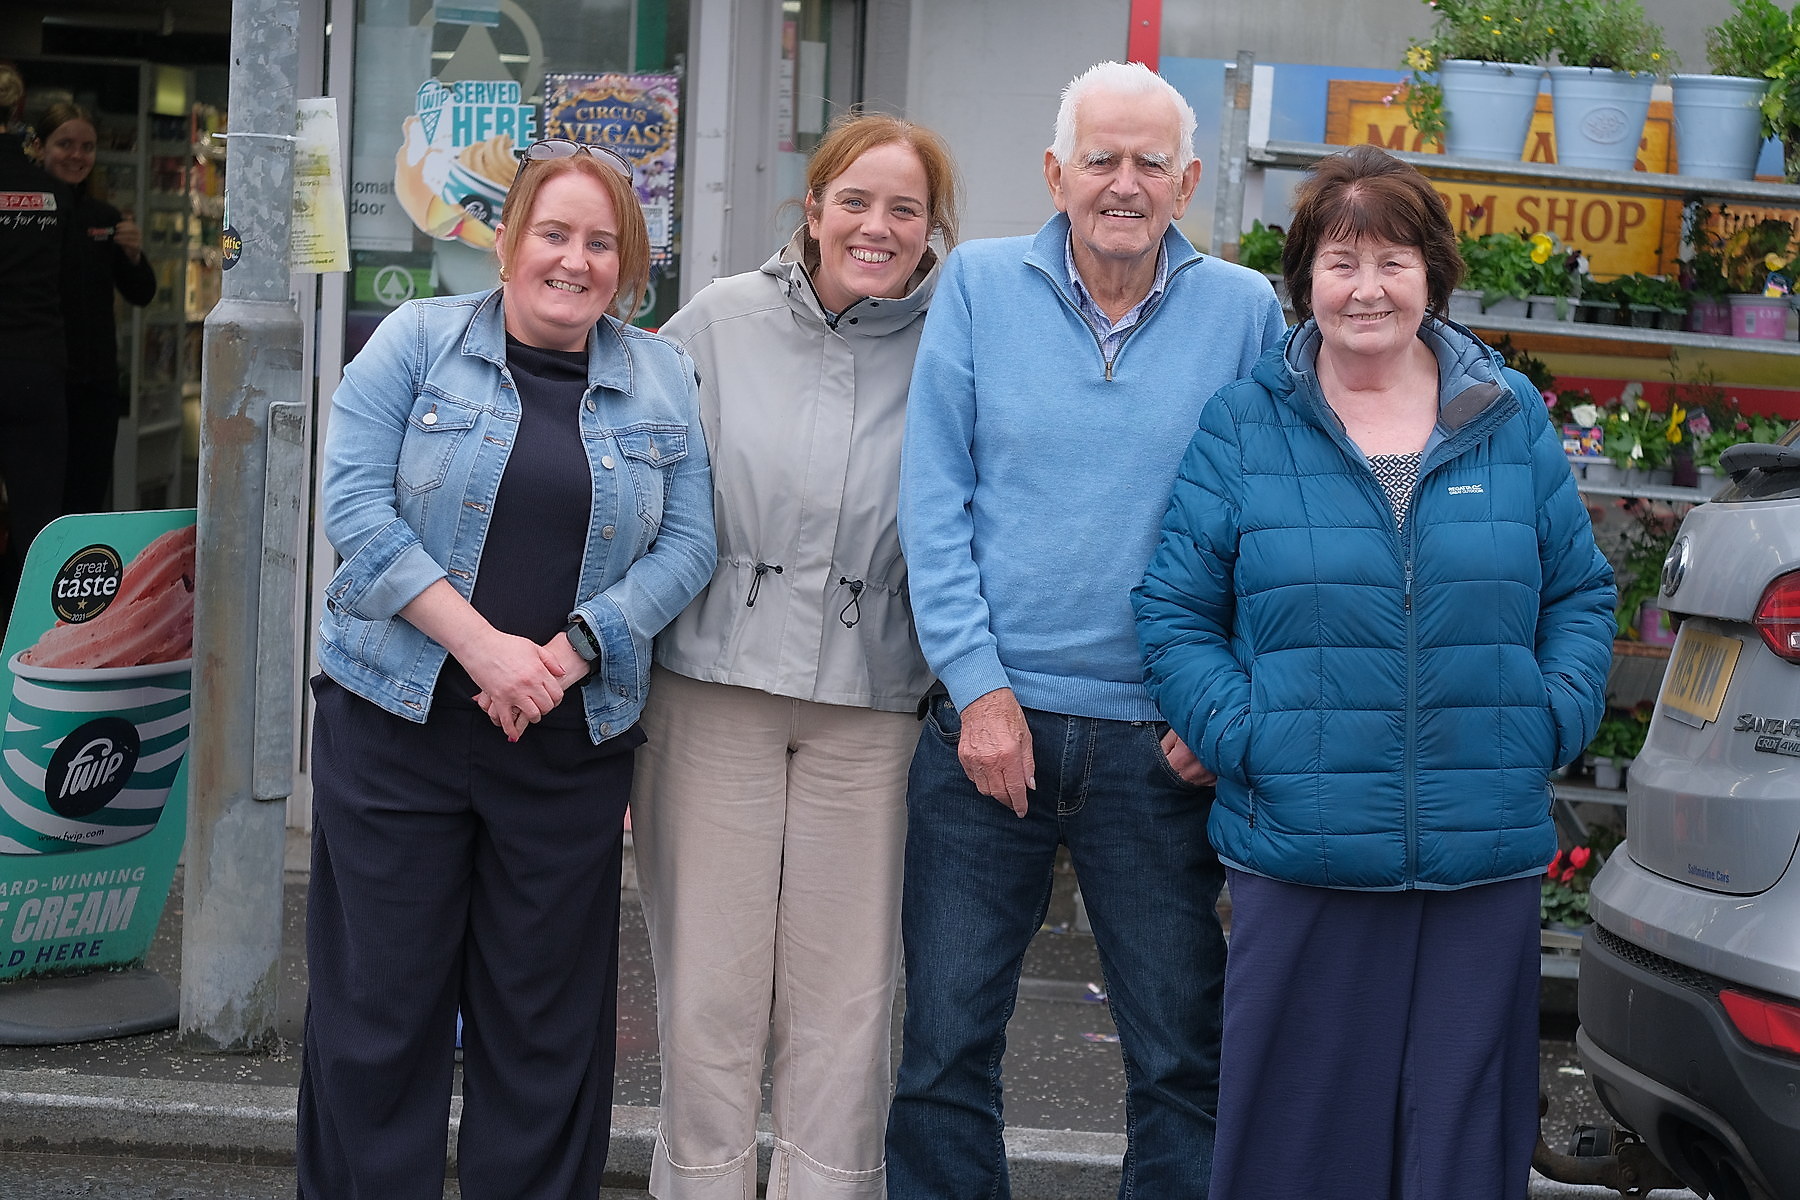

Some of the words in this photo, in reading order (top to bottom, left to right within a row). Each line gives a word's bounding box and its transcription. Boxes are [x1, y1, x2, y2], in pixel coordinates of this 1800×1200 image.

[417, 81, 450, 112] fwip
[453, 81, 519, 104] SERVED
[576, 106, 647, 122] CIRCUS
[452, 106, 536, 148] HERE
[562, 122, 662, 146] VEGAS
[12, 210, 35, 230] for
[1514, 195, 1648, 245] SHOP
[73, 559, 109, 579] great
[57, 574, 118, 599] taste
[71, 612, 86, 622] 2021
[58, 738, 124, 799] fwip
[39, 829, 105, 844] www.fwip.com
[1716, 870, 1730, 883] Cars
[11, 886, 140, 944] CREAM
[35, 940, 104, 964] HERE
